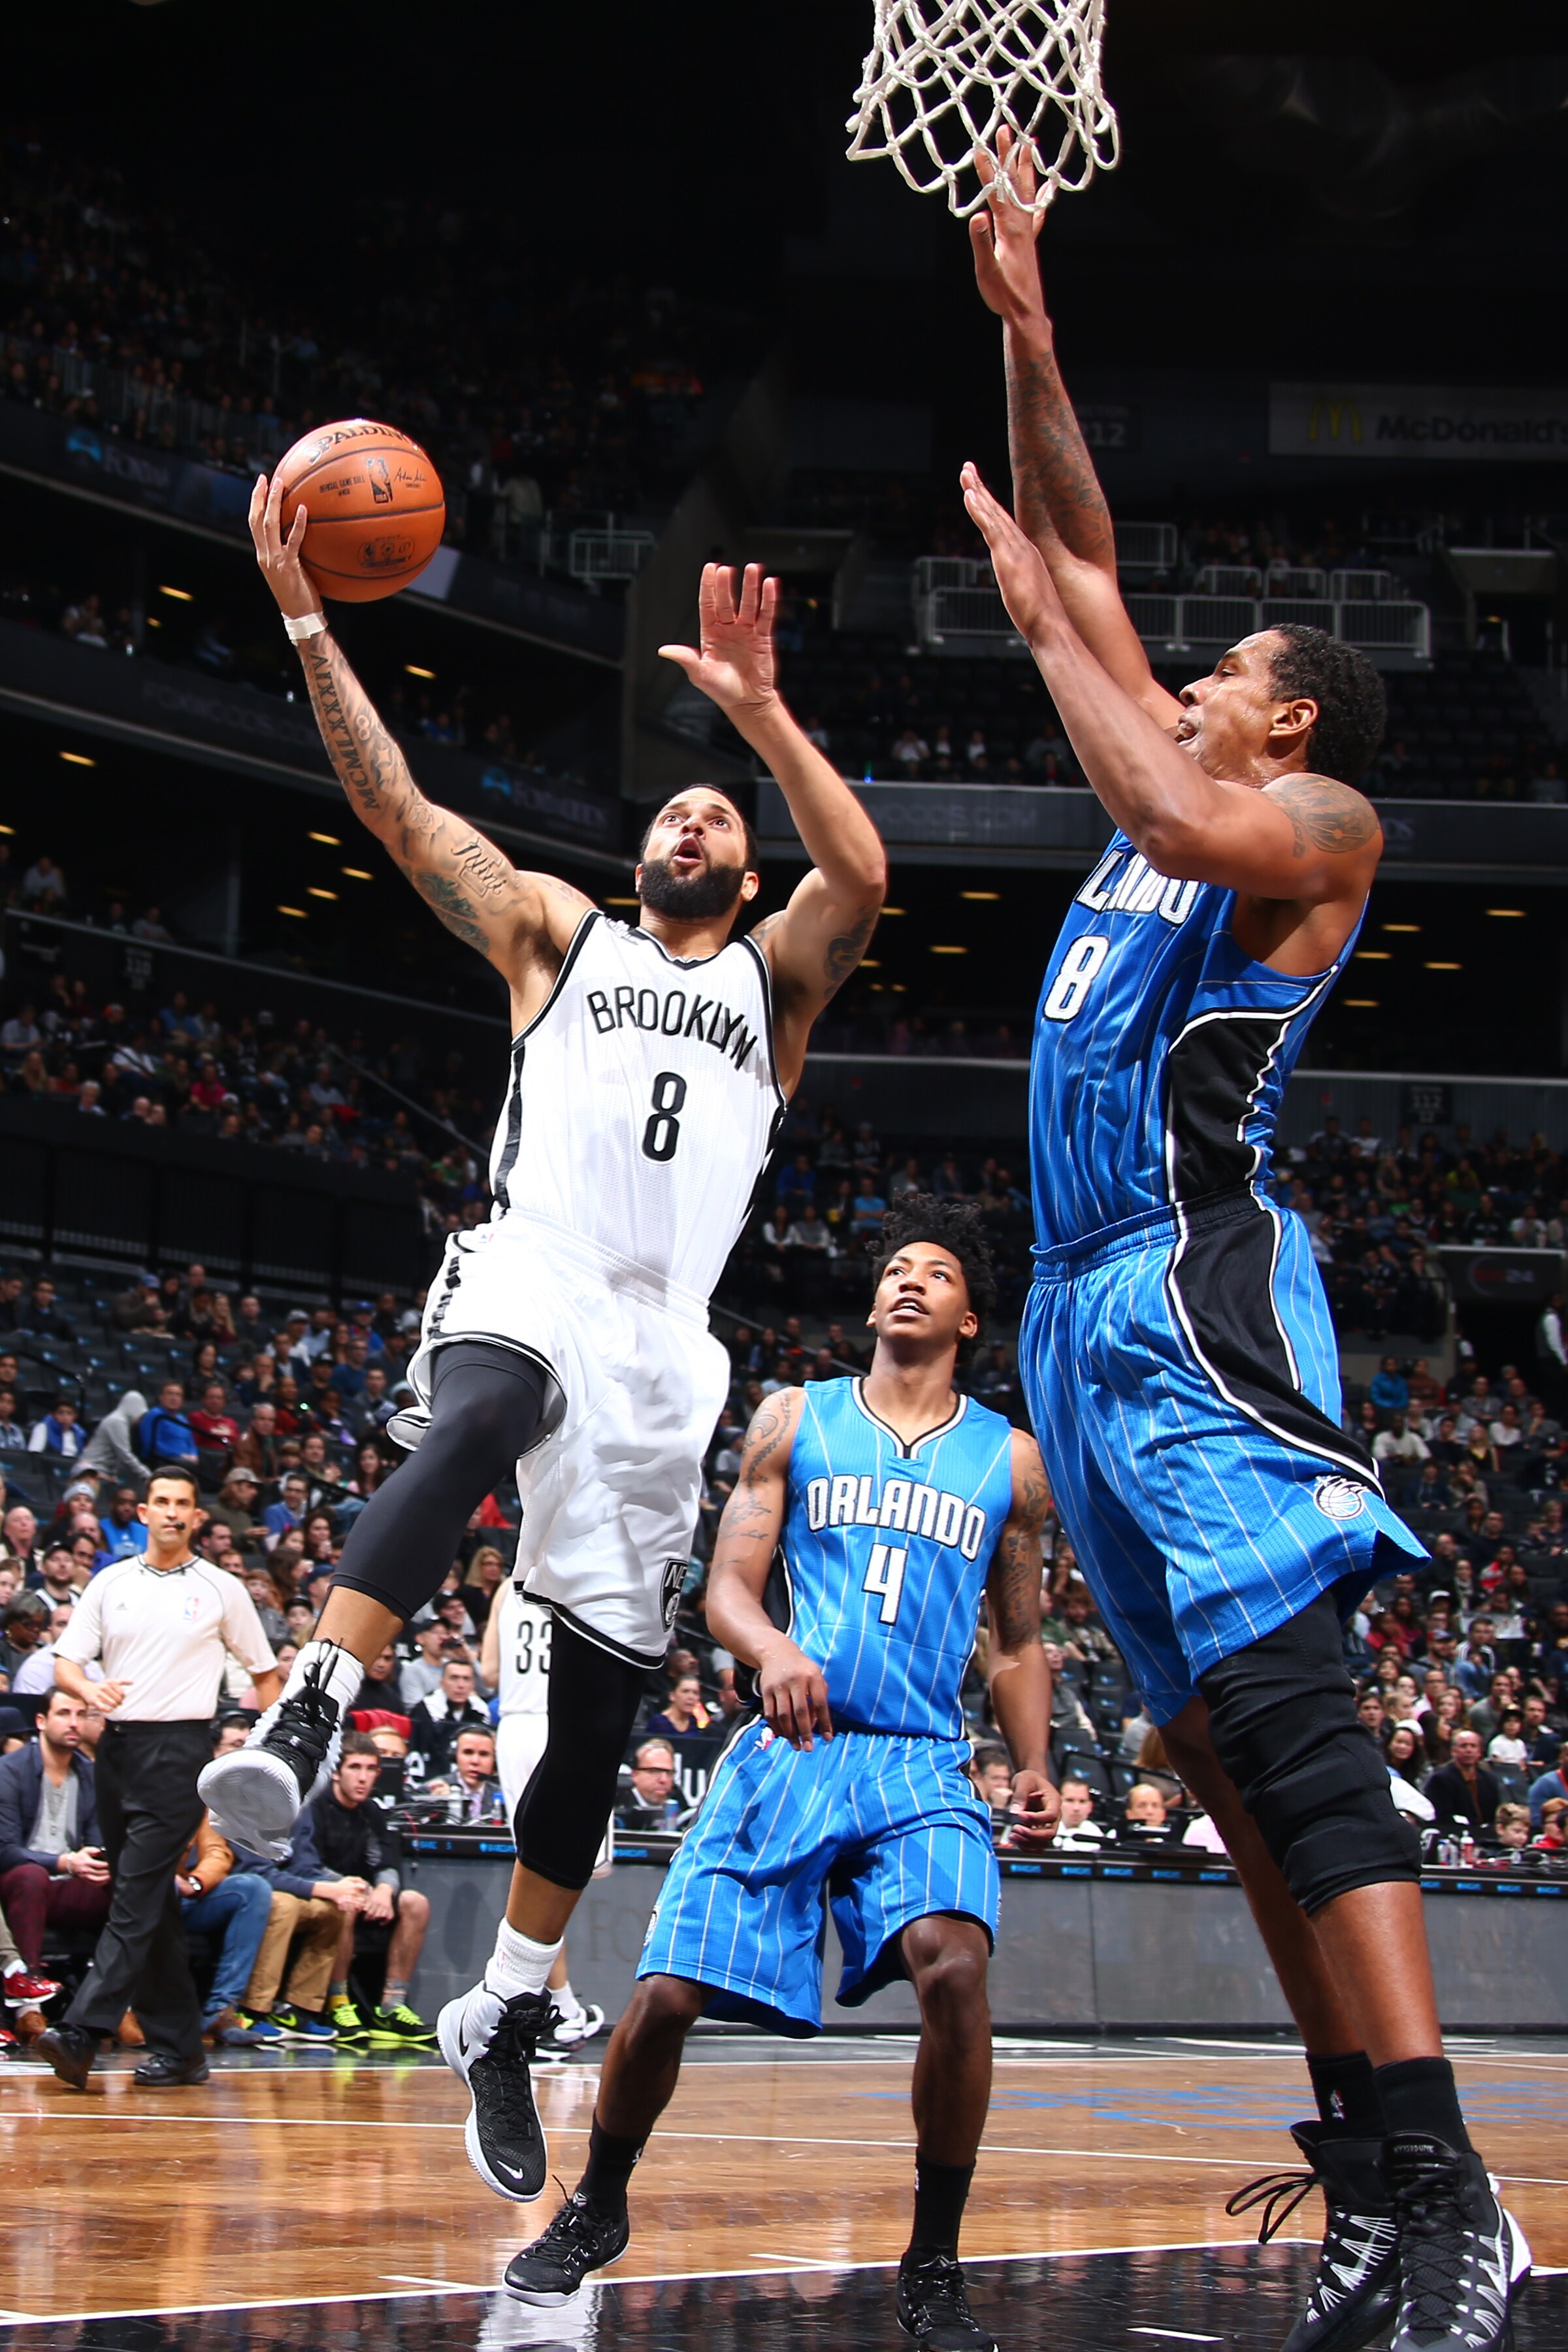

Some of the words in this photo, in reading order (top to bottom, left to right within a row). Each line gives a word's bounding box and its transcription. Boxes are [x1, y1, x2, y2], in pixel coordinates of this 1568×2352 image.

[1082, 421, 1126, 446] 12
[1043, 935, 1111, 1024] 8
[586, 985, 758, 1072] BROOKLYN
[641, 1071, 687, 1163] 8
[806, 1475, 987, 1561] ORLANDO
[861, 1543, 908, 1625] 4
[515, 1620, 553, 1674] 33
